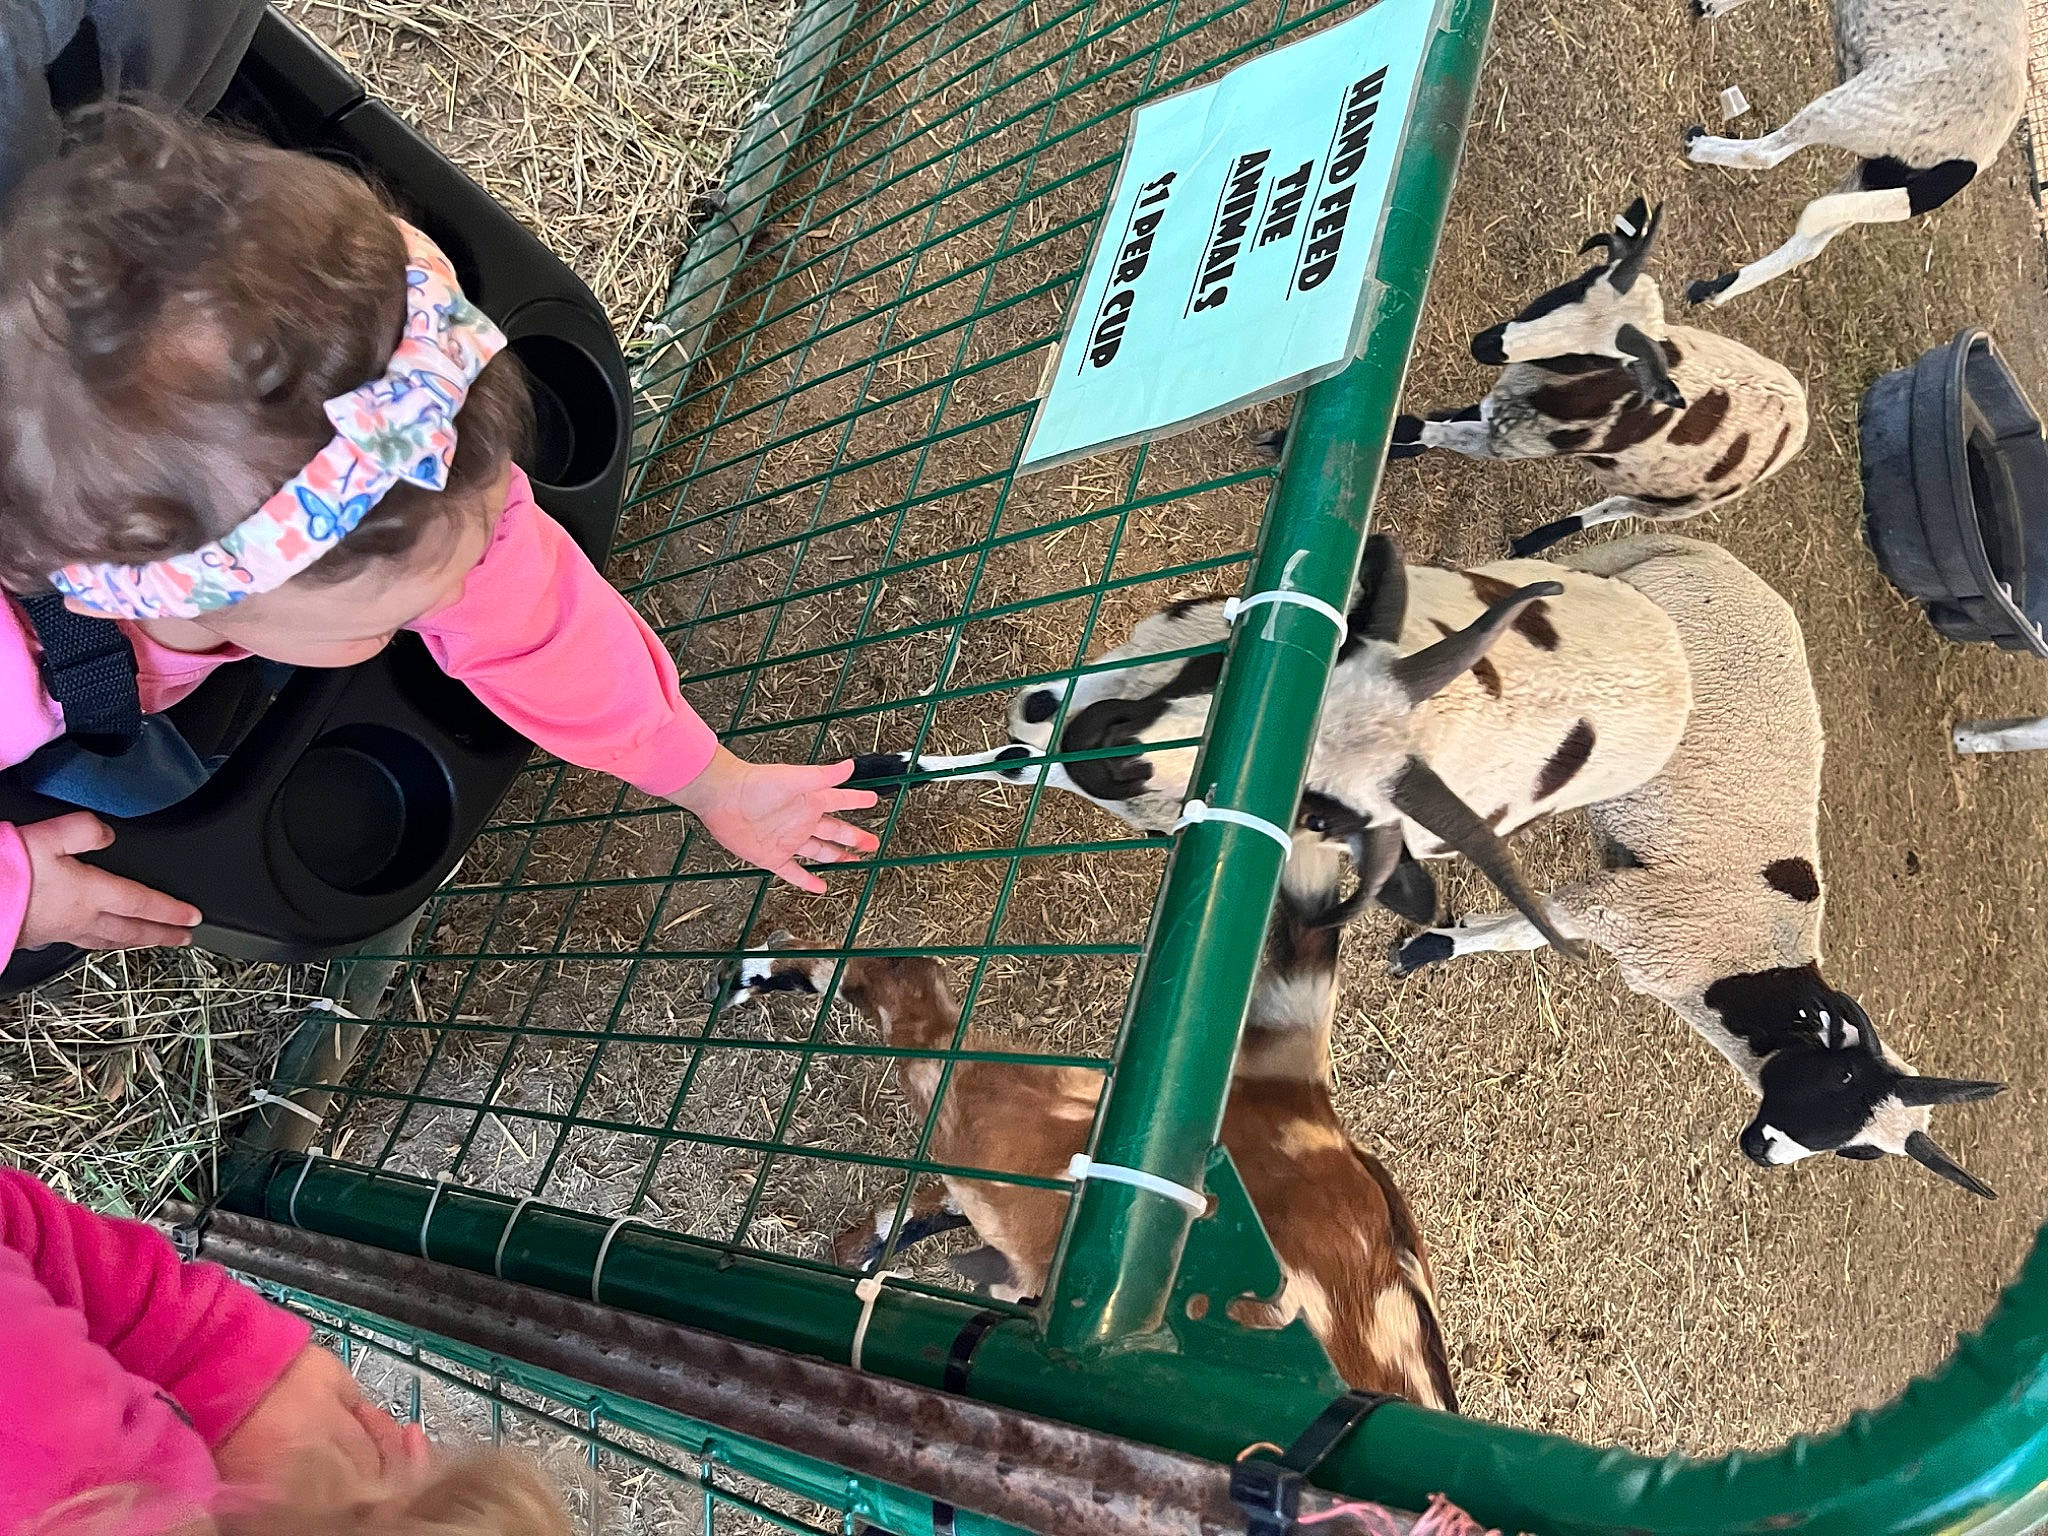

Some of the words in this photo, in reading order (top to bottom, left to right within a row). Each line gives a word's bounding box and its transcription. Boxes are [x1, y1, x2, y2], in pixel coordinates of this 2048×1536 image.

[1329, 65, 1389, 185] HAND
[1139, 171, 1178, 208] $1
[1194, 149, 1272, 313] ANIMALS
[1259, 160, 1315, 247] THE
[1113, 208, 1165, 287] PER
[1298, 182, 1357, 291] FEED
[1090, 289, 1135, 369] CUP
